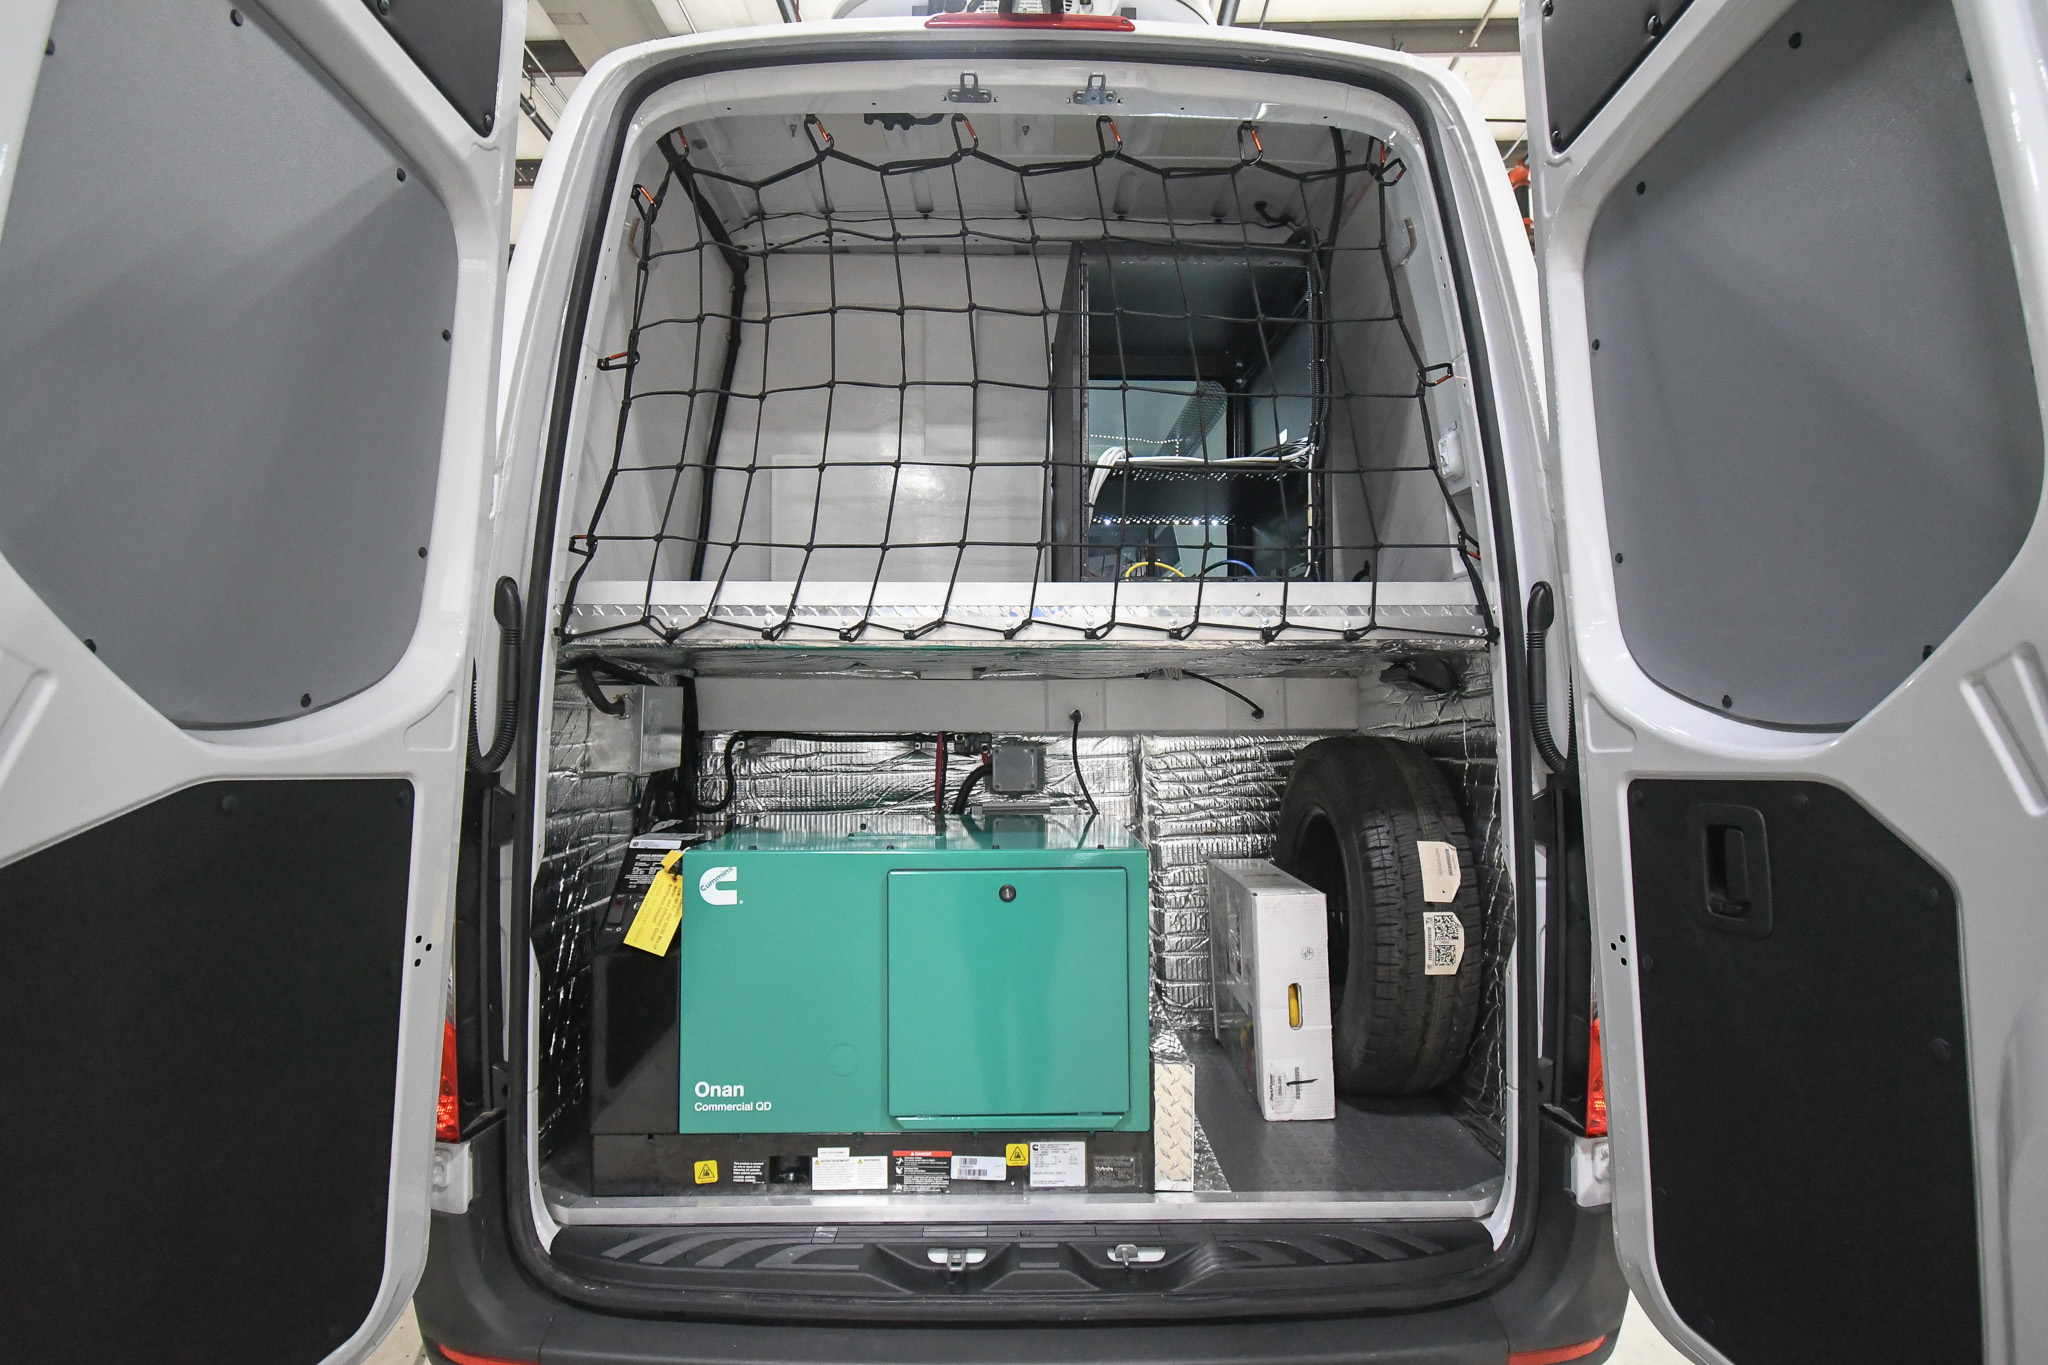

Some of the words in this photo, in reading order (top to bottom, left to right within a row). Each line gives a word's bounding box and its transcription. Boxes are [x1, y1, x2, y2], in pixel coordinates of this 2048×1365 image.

[700, 867, 733, 891] Cummins
[695, 1081, 744, 1098] Onan
[694, 1102, 753, 1111] Commercial
[756, 1101, 771, 1111] QD
